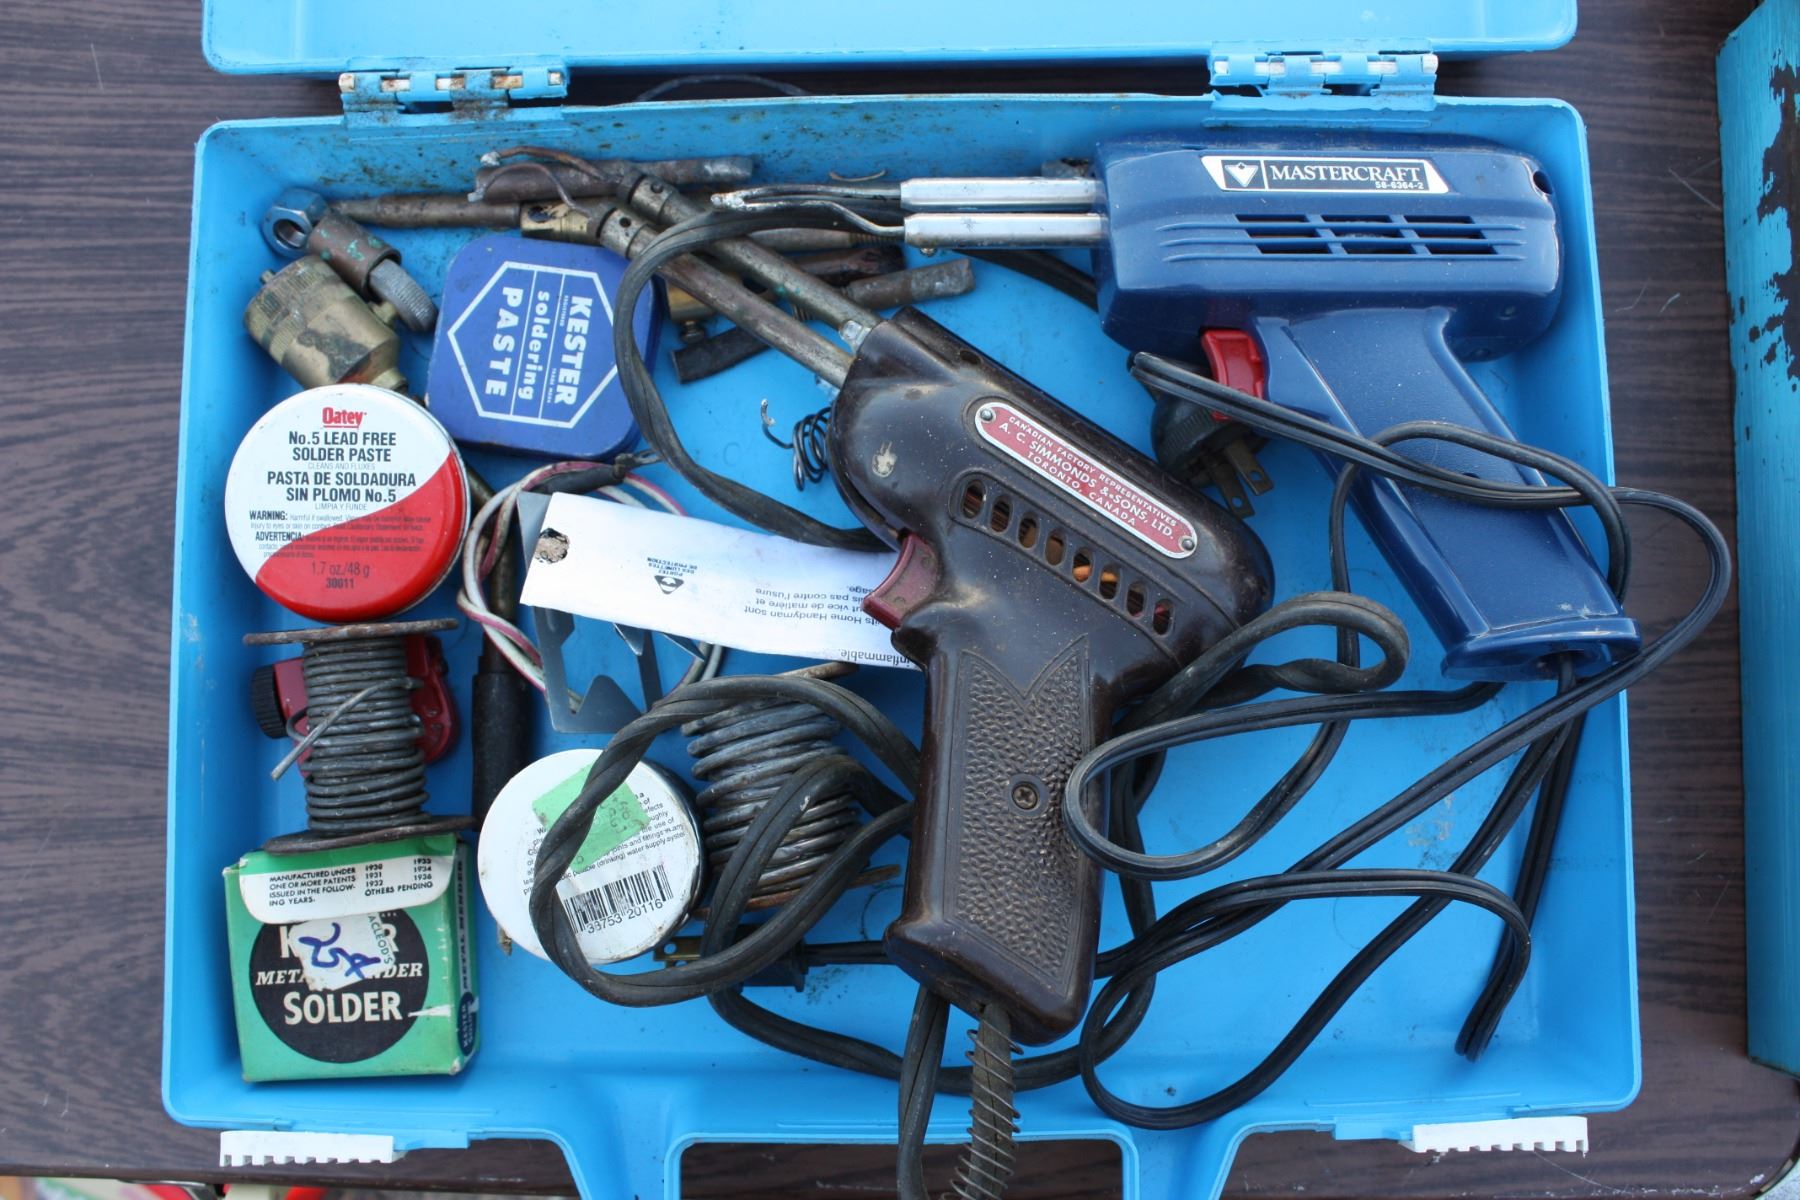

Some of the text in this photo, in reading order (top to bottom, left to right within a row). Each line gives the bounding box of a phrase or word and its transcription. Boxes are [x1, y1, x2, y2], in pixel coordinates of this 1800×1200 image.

[1269, 165, 1420, 182] MASTERCRAFT
[485, 287, 524, 396] PASTE
[518, 290, 551, 400] soldering
[554, 296, 593, 405] KESTER
[322, 407, 364, 427] Oatey
[289, 431, 397, 446] No.5 LEAD FREE
[292, 448, 392, 462] SOLDER PASTE
[308, 462, 335, 470] CLEANS
[1009, 416, 1177, 527] CANADIAN FACTORY REPRESENTATIVES
[267, 471, 416, 487] PASTA DE SOLDADURA
[999, 422, 1174, 540] A. C. SIMMONDS & SONS, LTD.
[286, 487, 397, 503] SIN PLOMO No.5
[1026, 451, 1136, 526] TORONTO, CANADA
[345, 503, 367, 511] FUNDE
[249, 510, 288, 520] WARNING:
[312, 561, 327, 575] 1.7
[326, 577, 354, 589] 30011
[755, 588, 790, 600] l'usure
[794, 592, 827, 600] contre
[830, 593, 849, 602] pas
[744, 605, 767, 615] sont
[769, 599, 808, 609] matière
[811, 602, 825, 610] de
[828, 603, 849, 611] vice
[770, 610, 828, 621] Handyman
[830, 614, 862, 624] Home
[839, 648, 911, 670] inflammable.
[630, 838, 641, 847] and
[627, 845, 644, 856] water
[269, 870, 330, 882] MANUFACTURED
[331, 867, 356, 877] UNDER
[269, 882, 287, 891] ONE
[288, 881, 299, 889] OR
[300, 879, 322, 887] MORE
[323, 876, 356, 886] PATENTS
[269, 890, 295, 898] ISSUED
[307, 887, 321, 895] THE
[322, 884, 356, 893] FOLLOW-
[269, 881, 433, 907] ING YEARS. OTHERS PENDING
[627, 900, 663, 919] 20116
[368, 915, 393, 965] ACLEOD'S
[283, 991, 402, 1025] SOLDER
